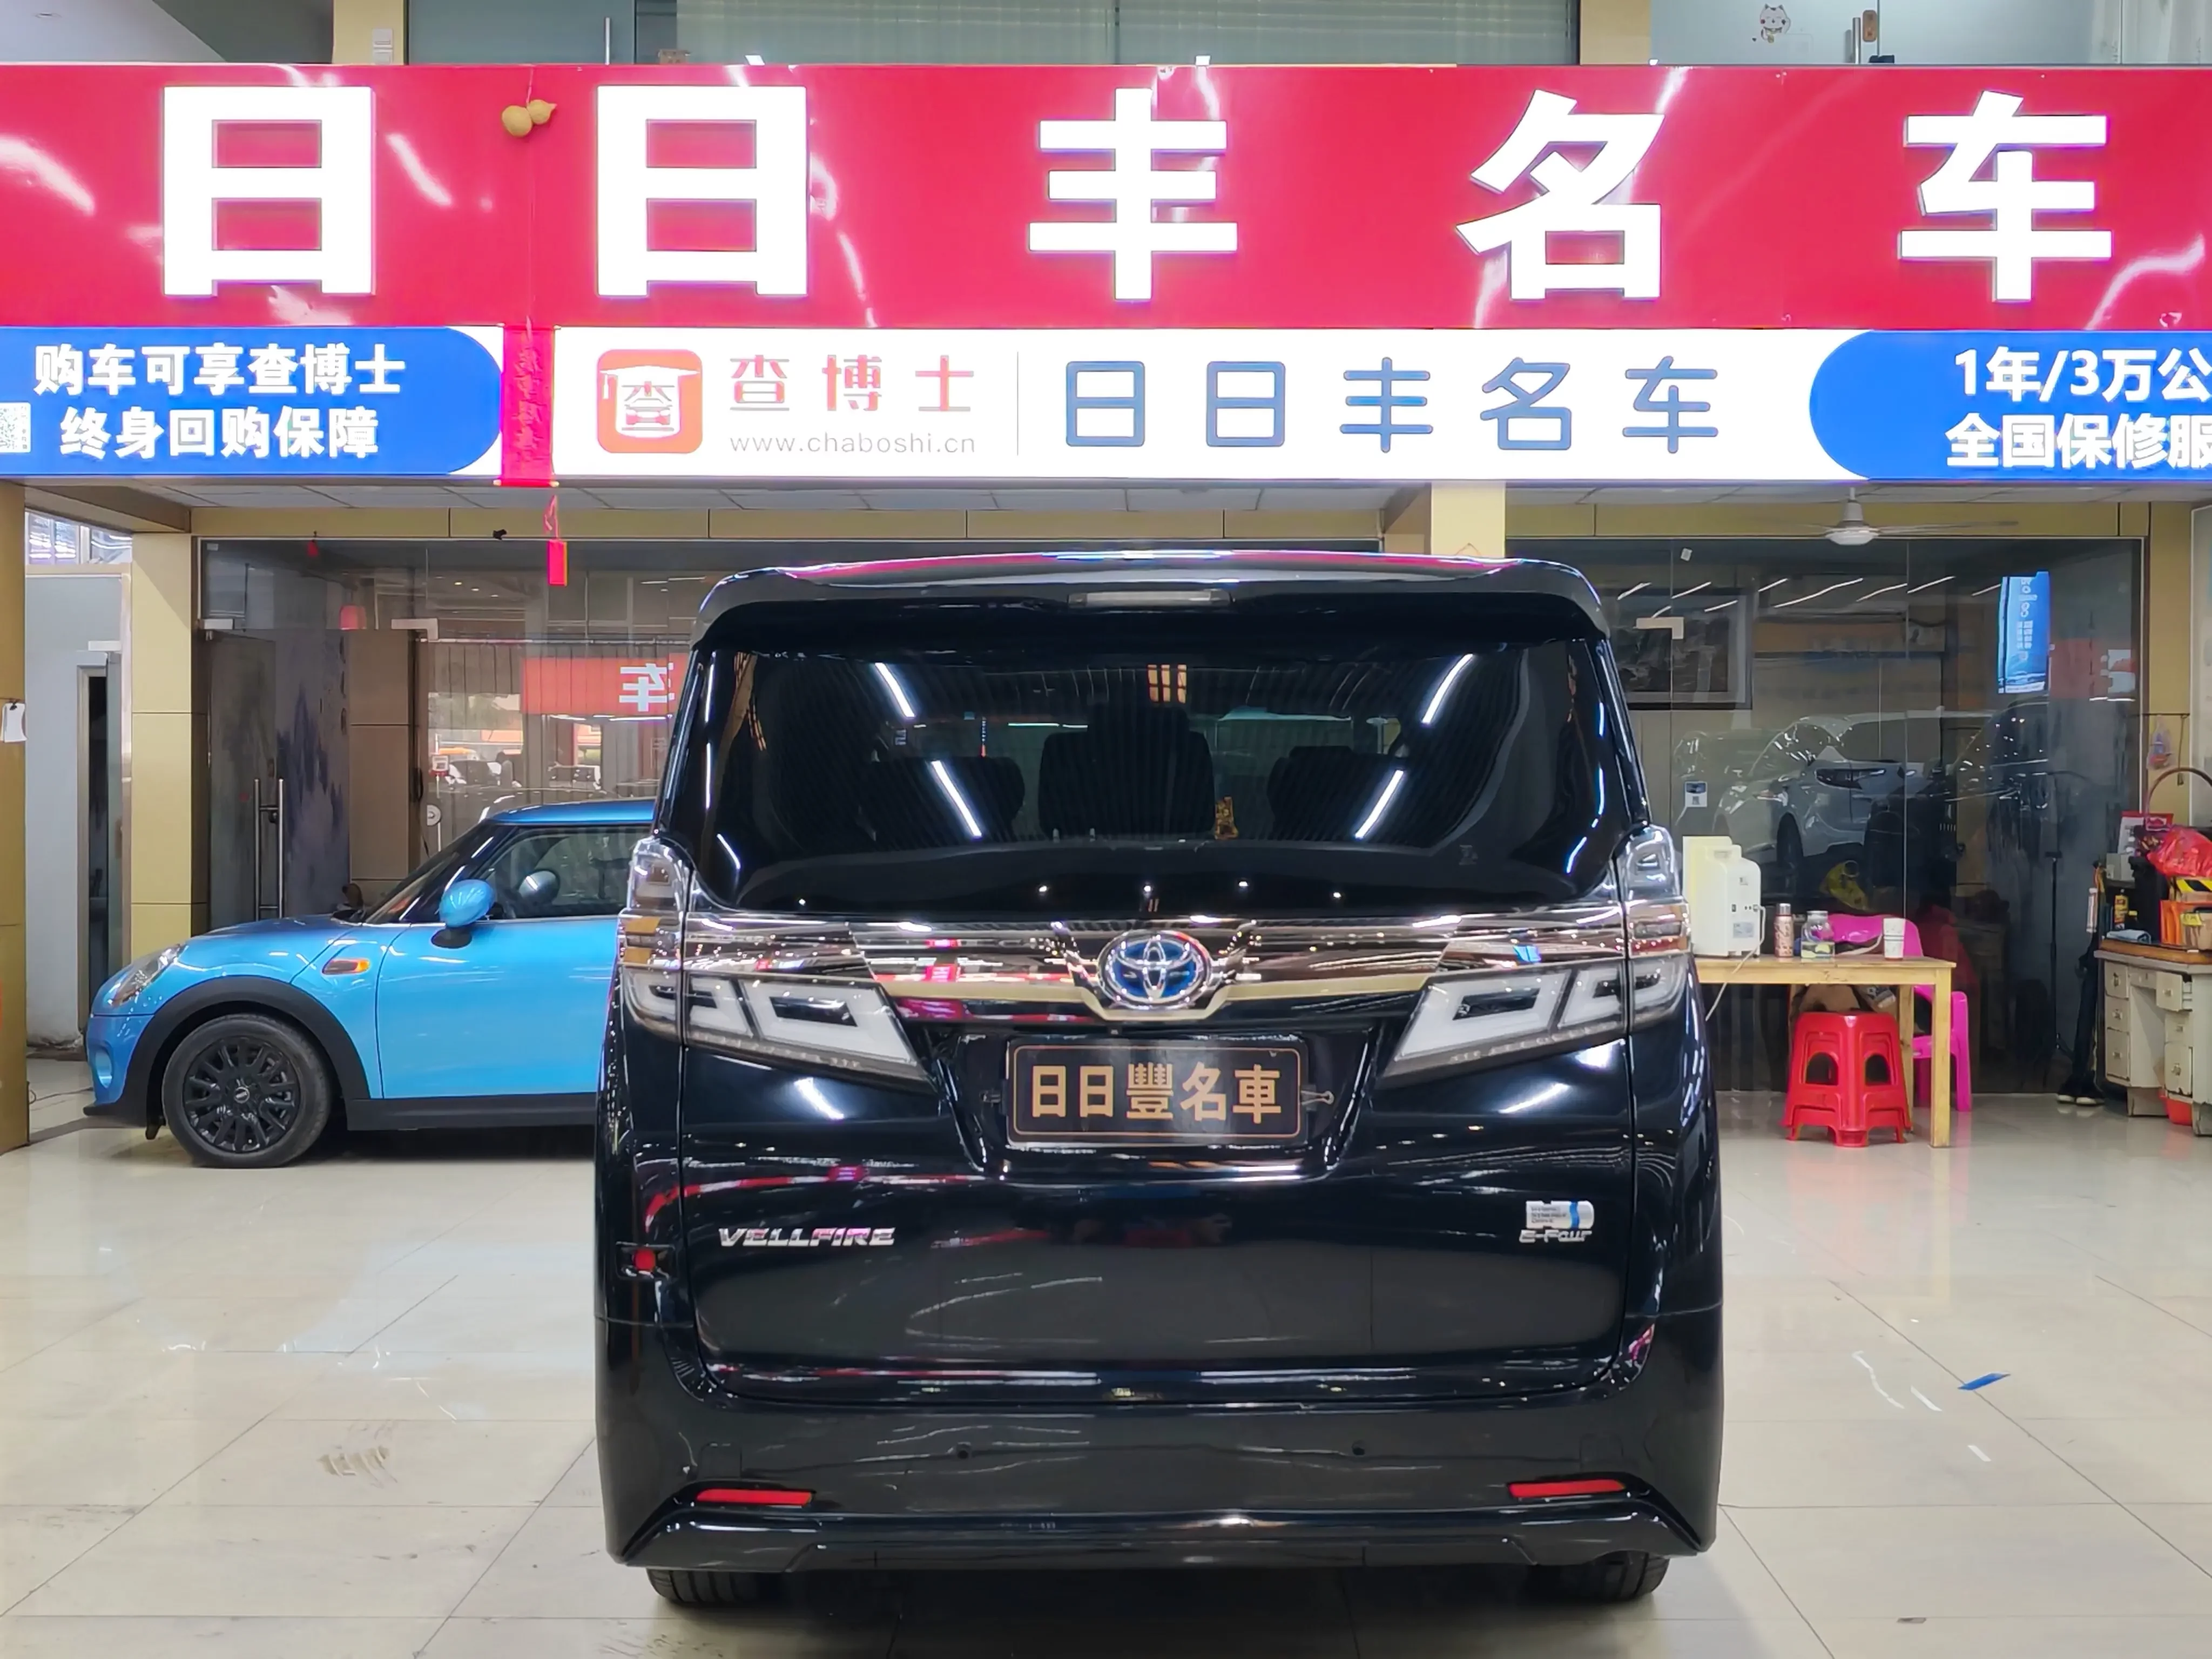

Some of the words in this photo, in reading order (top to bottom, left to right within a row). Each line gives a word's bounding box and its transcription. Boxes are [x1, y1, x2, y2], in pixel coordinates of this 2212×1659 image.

[163, 86, 2112, 302] 日日丰名车
[34, 342, 406, 395] 购车可享查博士
[730, 354, 974, 412] 查博士
[1954, 346, 2212, 403] 1年/3万公
[59, 406, 379, 459] 终身回购保障
[1065, 357, 1719, 454] 日日丰名车
[730, 433, 975, 454] www.chaboshi.cn
[1945, 413, 2212, 469] 全国保修服
[1032, 1062, 1282, 1124] 日日豐名車
[718, 1227, 896, 1247] VELLFIRE
